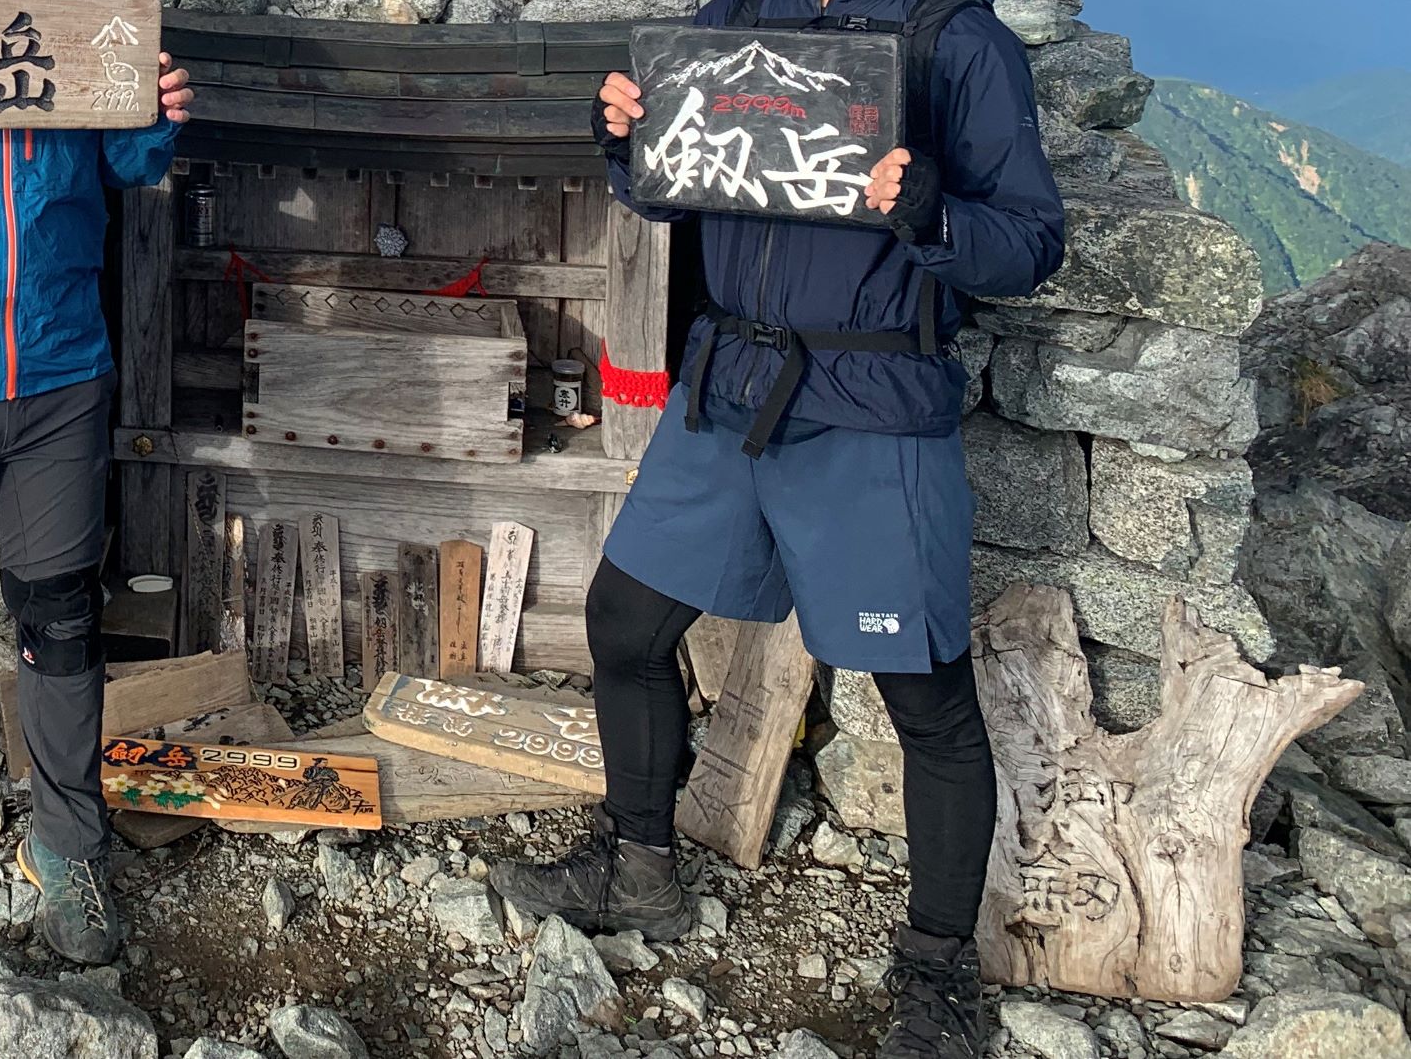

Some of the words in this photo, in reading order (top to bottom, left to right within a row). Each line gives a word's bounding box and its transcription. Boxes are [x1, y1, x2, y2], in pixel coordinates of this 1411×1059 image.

[712, 94, 807, 119] 2999m
[859, 617, 883, 625] HARD
[859, 624, 884, 633] WEAR
[200, 747, 301, 771] 2999
